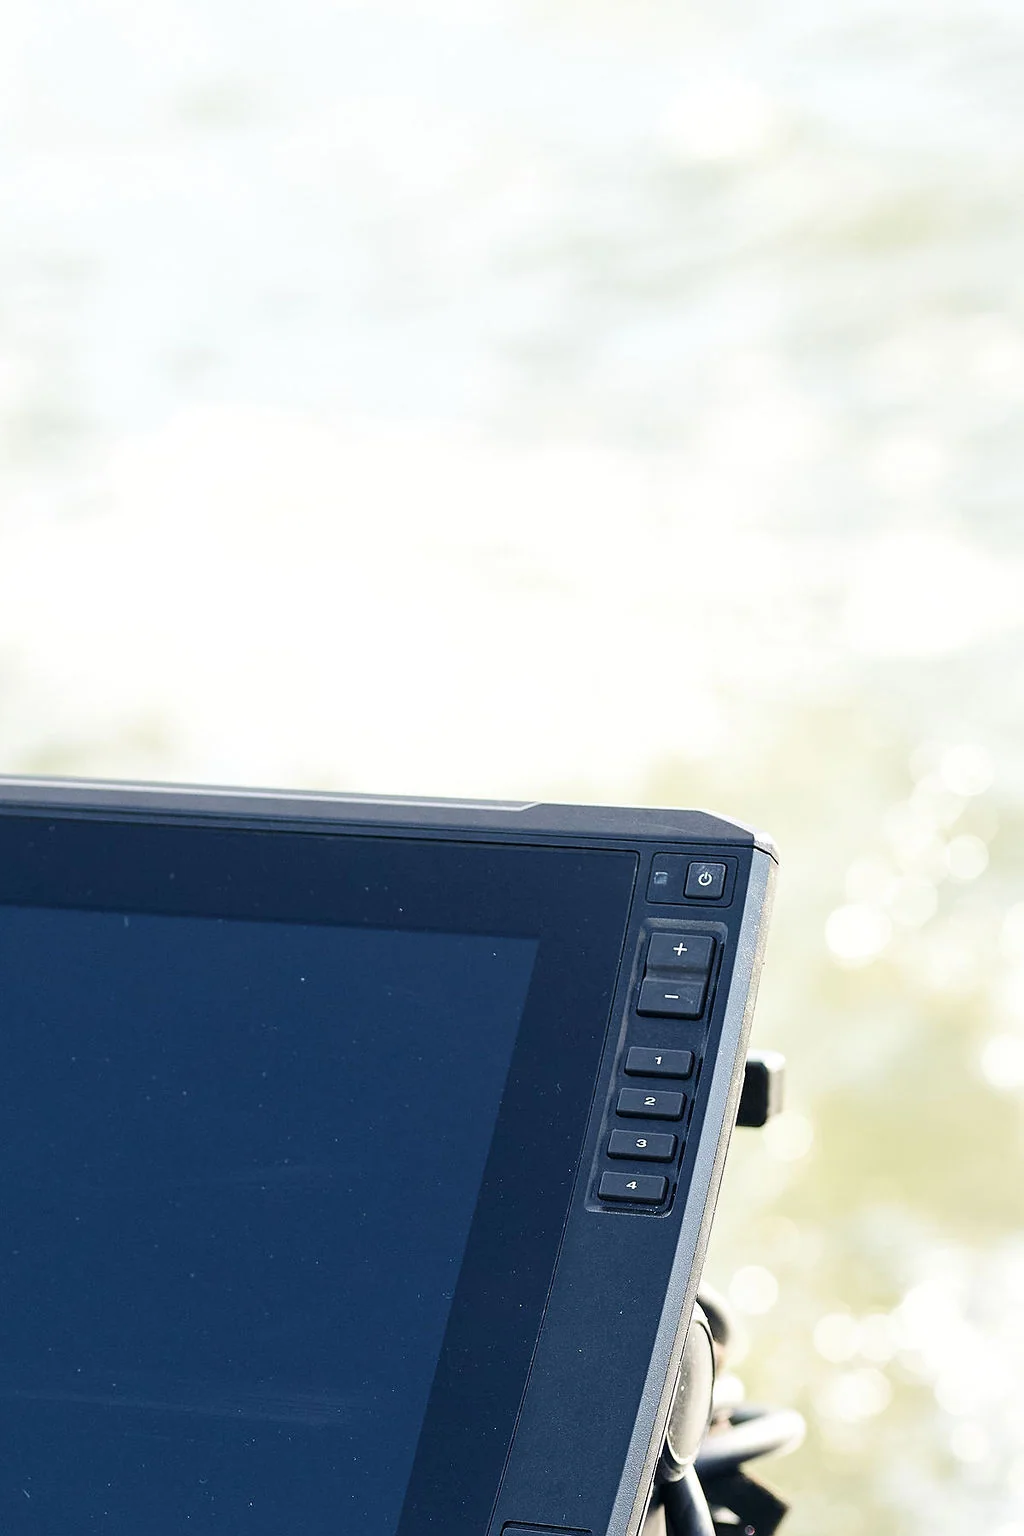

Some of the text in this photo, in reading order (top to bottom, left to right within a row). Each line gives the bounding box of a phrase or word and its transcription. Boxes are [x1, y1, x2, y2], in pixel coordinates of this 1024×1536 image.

[655, 1056, 663, 1066] 1
[644, 1096, 656, 1106] 2
[635, 1138, 647, 1148] 3
[625, 1181, 637, 1190] 4
